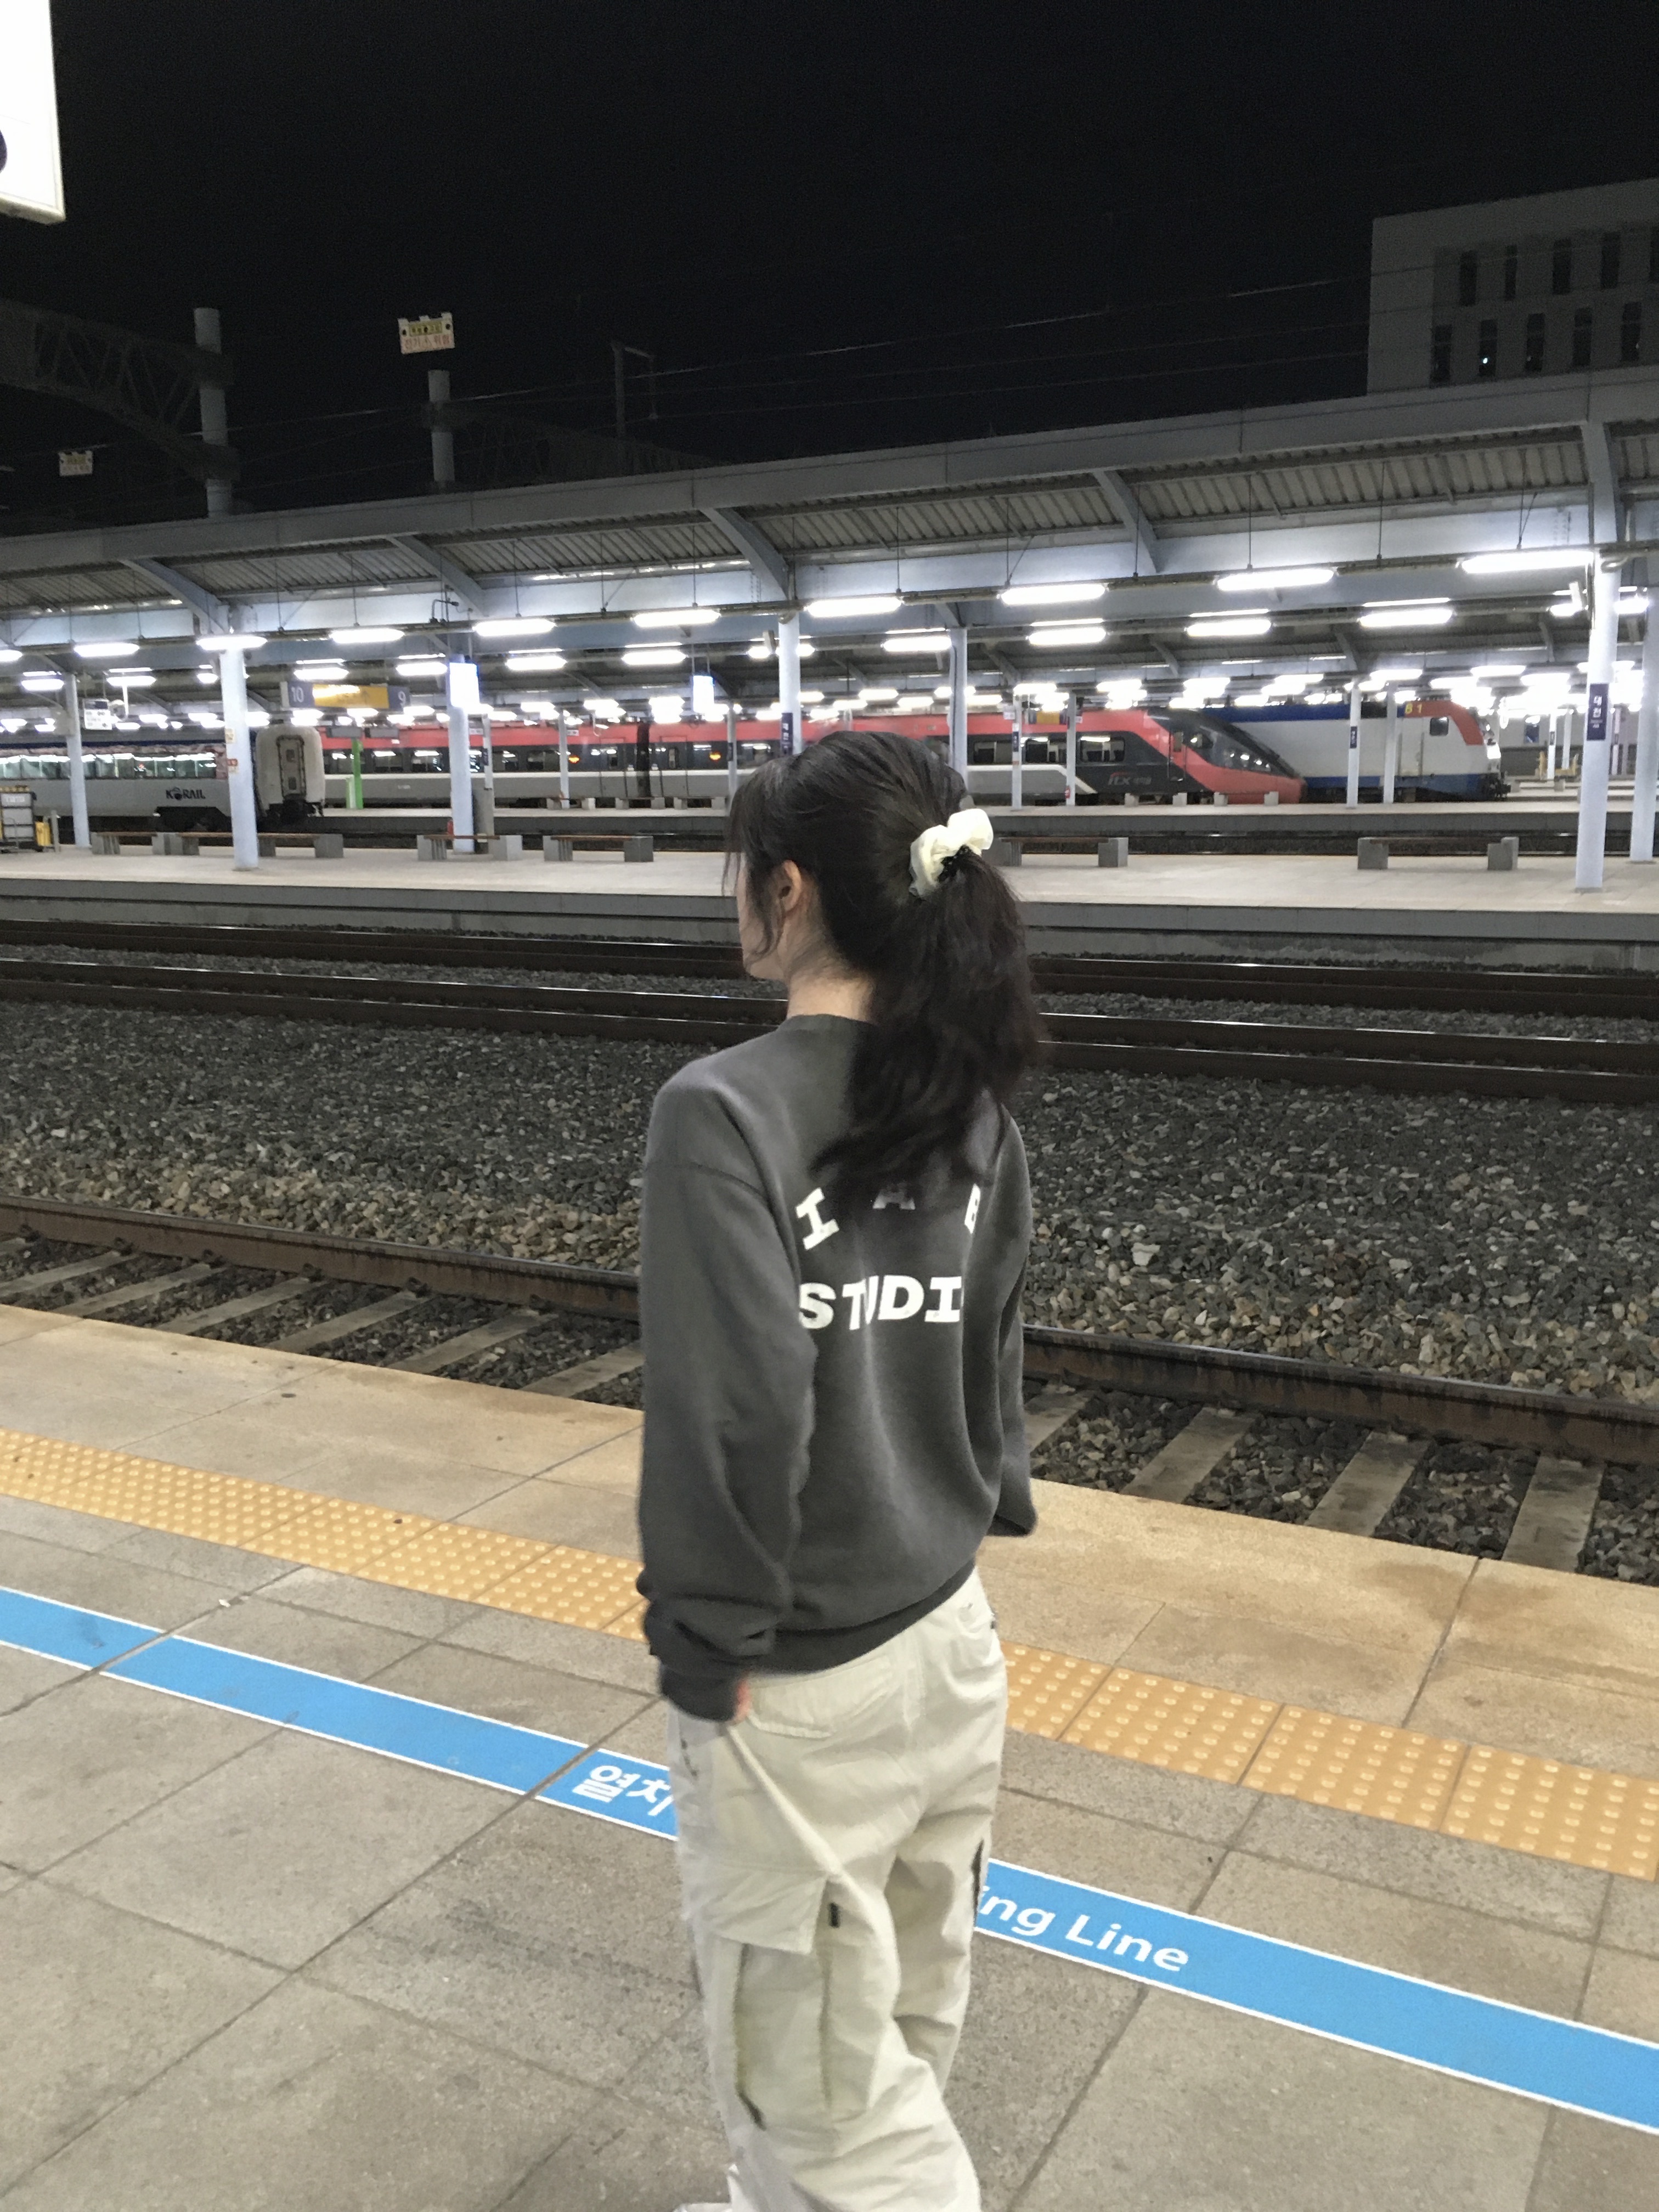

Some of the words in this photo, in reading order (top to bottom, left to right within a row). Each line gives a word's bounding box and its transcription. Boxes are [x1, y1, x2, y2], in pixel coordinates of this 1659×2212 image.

[291, 687, 304, 703] 10
[398, 691, 407, 707] 9
[166, 787, 206, 800] KORAIL
[1065, 1915, 1189, 1971] Line
